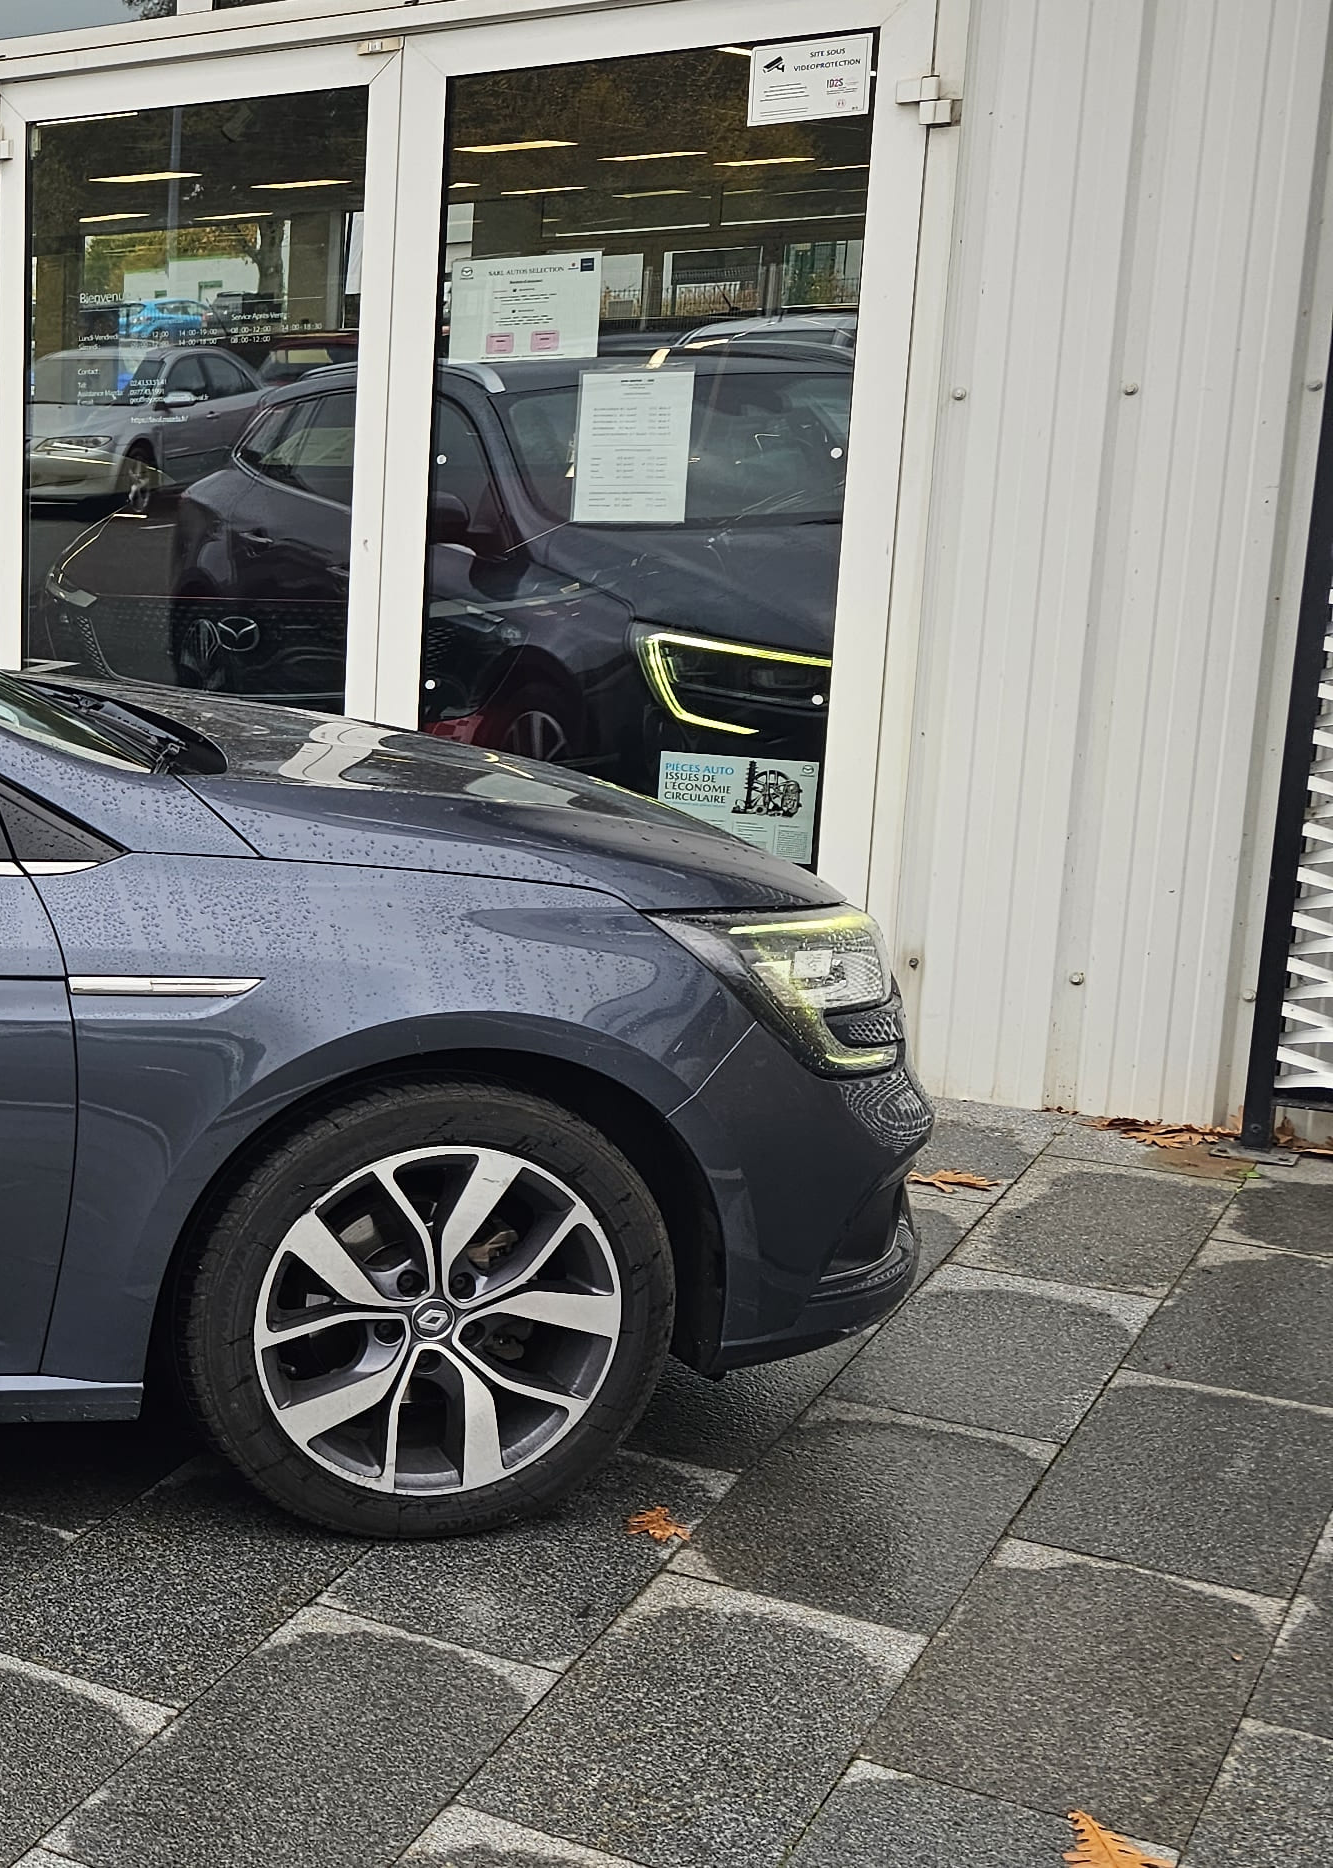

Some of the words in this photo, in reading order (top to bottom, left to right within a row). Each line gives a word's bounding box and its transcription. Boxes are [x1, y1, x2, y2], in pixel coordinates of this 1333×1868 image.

[810, 50, 825, 58] SITE
[826, 48, 846, 57] SOUS
[793, 58, 861, 72] VIDEOPROTECTION
[703, 765, 734, 776] AUTO
[665, 772, 699, 782] ISSUES
[702, 774, 716, 783] DE
[664, 791, 726, 803] CIRCULAIRE
